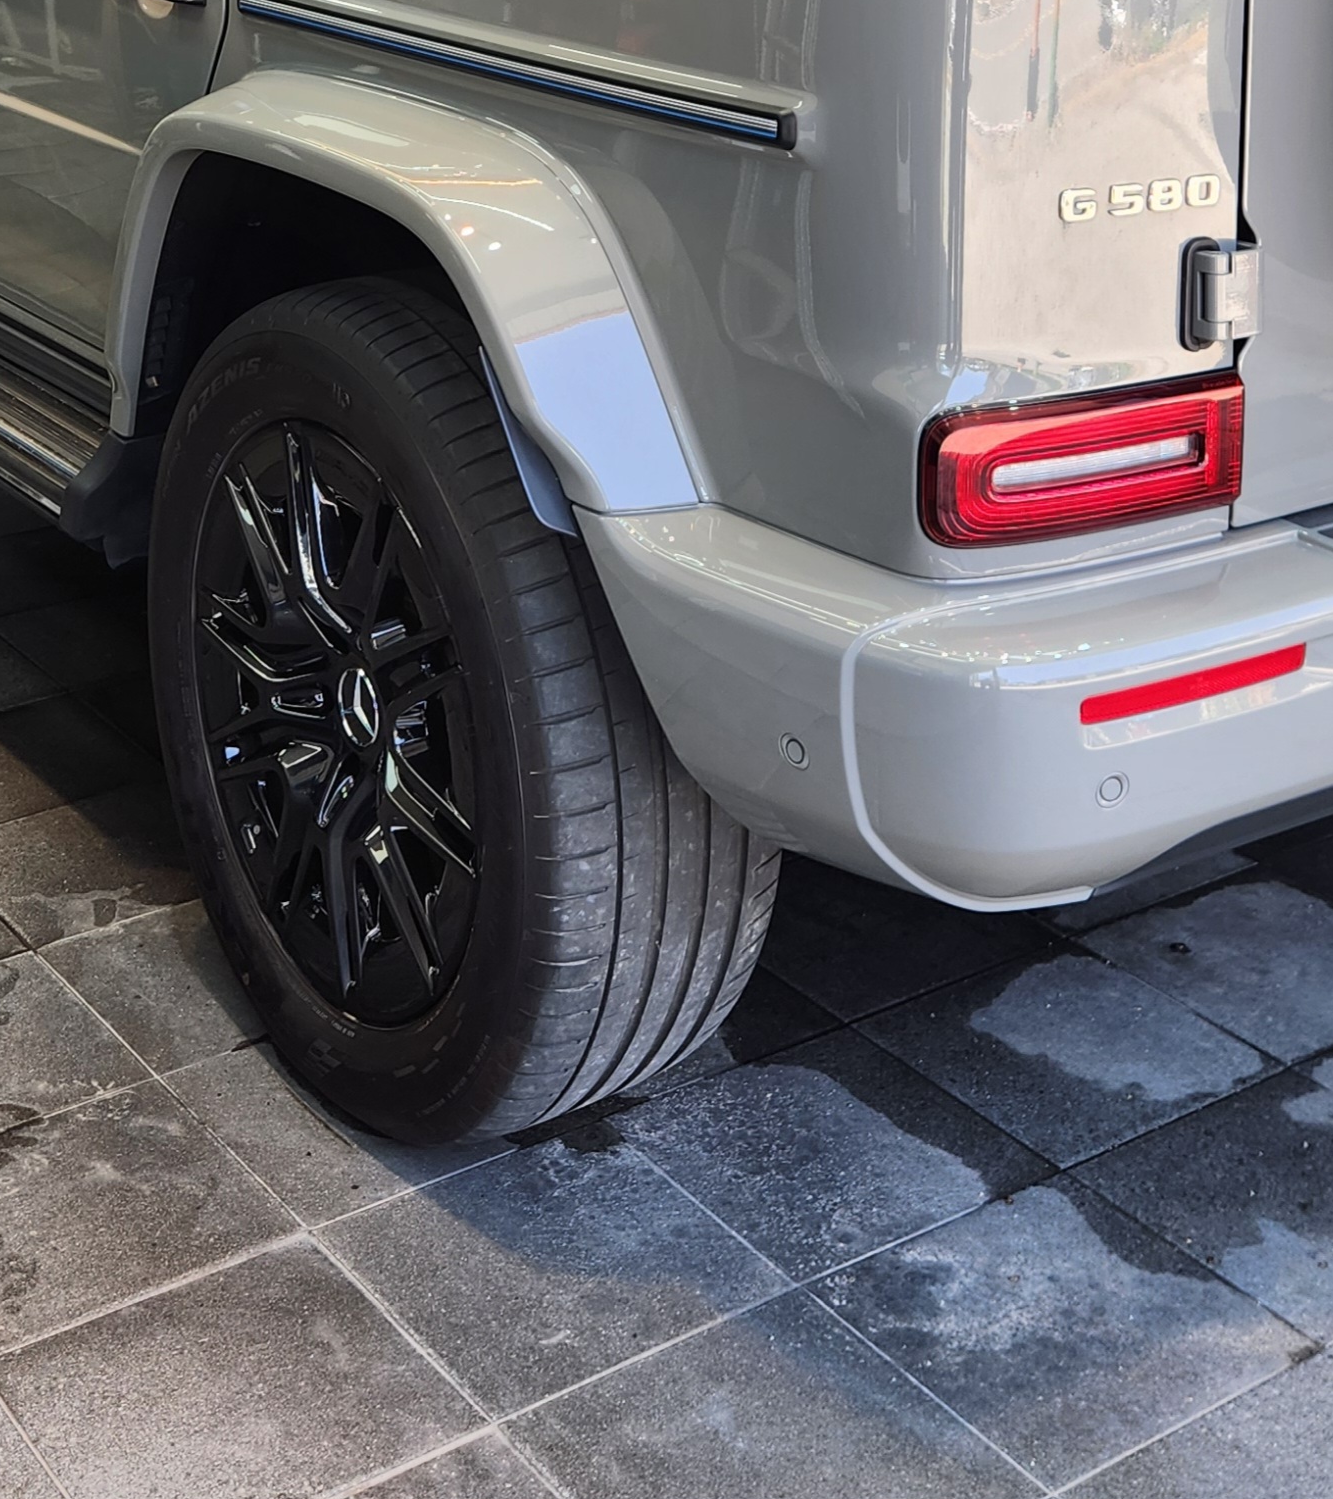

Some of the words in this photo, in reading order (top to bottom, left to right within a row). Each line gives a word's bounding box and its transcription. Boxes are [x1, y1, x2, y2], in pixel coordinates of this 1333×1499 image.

[1058, 187, 1098, 223] G
[1108, 173, 1221, 216] 580
[186, 357, 262, 437] AZENIS
